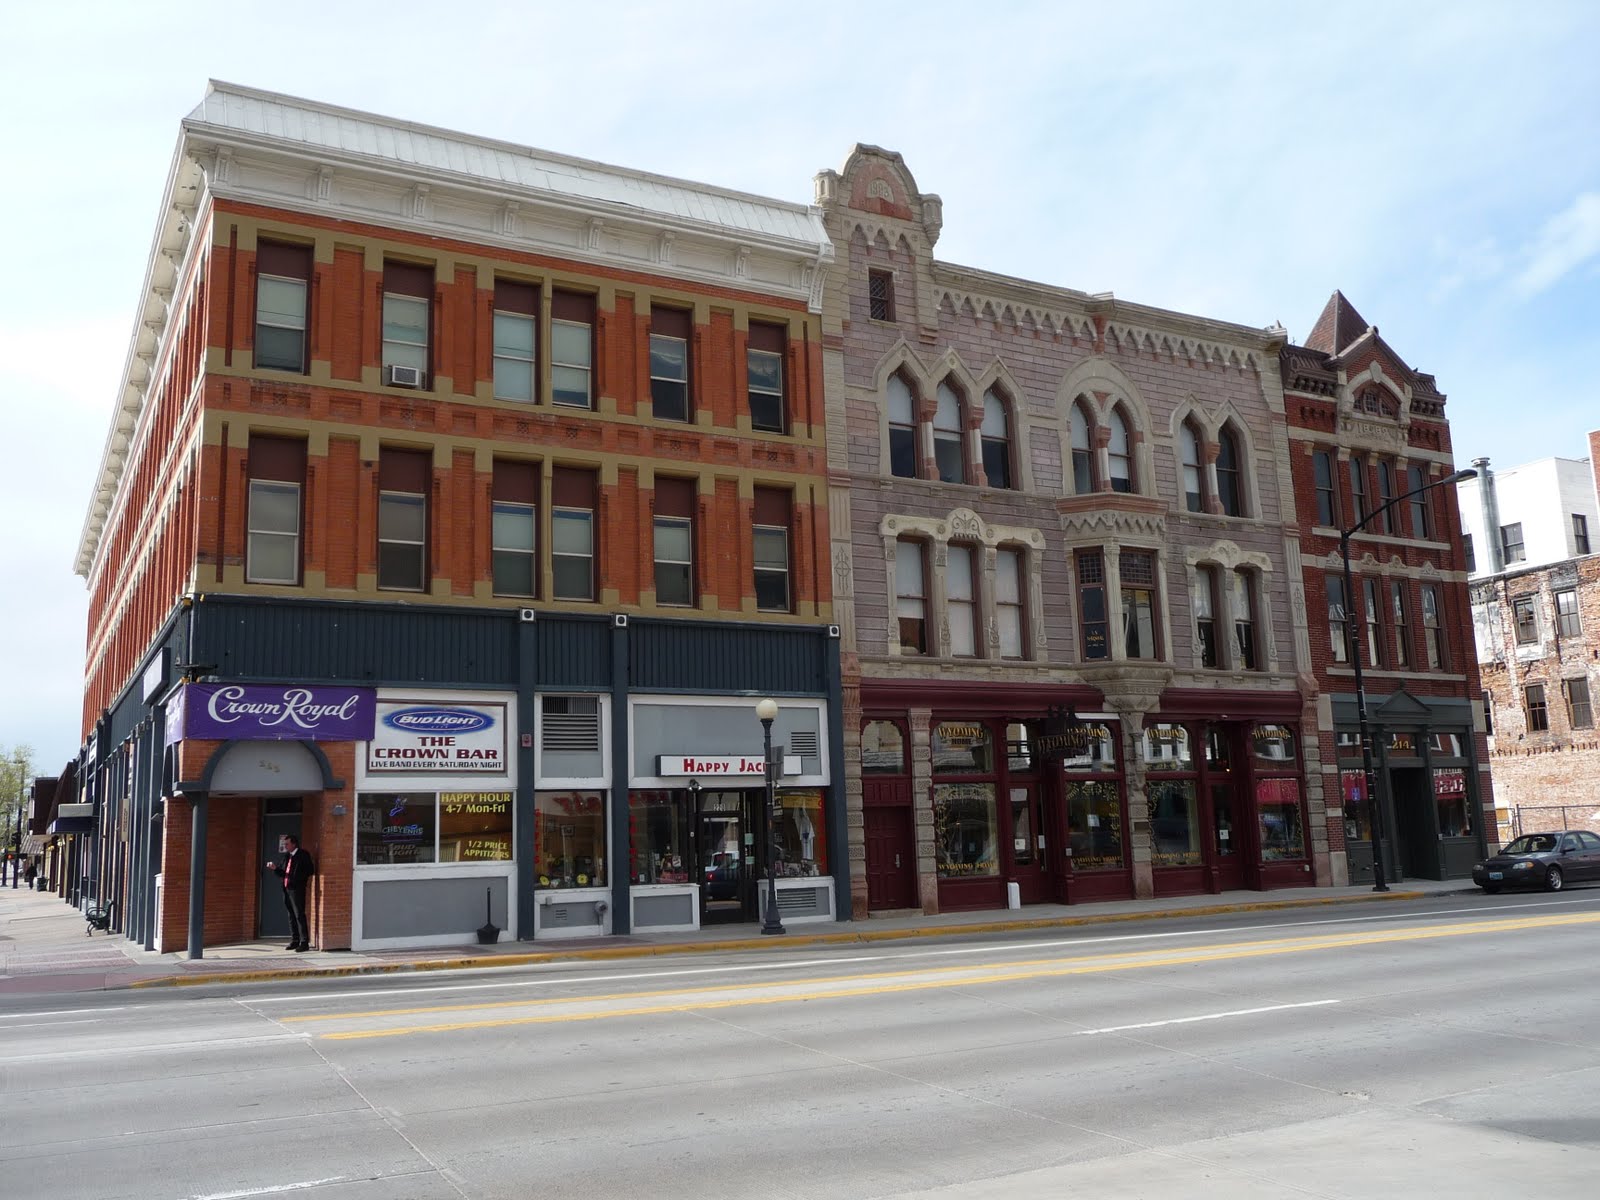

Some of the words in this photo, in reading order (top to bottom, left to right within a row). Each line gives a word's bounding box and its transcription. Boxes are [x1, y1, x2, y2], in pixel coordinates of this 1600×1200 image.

[208, 685, 281, 723] Crown
[259, 688, 360, 729] Royal
[398, 715, 432, 725] BUD
[433, 715, 478, 725] LIGHT
[937, 727, 984, 739] WYOMING
[417, 736, 456, 747] THE
[1392, 740, 1410, 750] 214
[374, 748, 449, 759] CROWN
[456, 749, 498, 760] BAR
[480, 761, 502, 769] NIGHT
[683, 758, 730, 773] HAPPY
[441, 793, 476, 803] HAPPY
[479, 793, 511, 802] HOUR
[445, 804, 462, 813] 4-7
[466, 803, 506, 813] Mon-Fri
[467, 840, 483, 848] 1/2
[484, 841, 508, 849] PRICE
[464, 848, 510, 859] APPITIZERS
